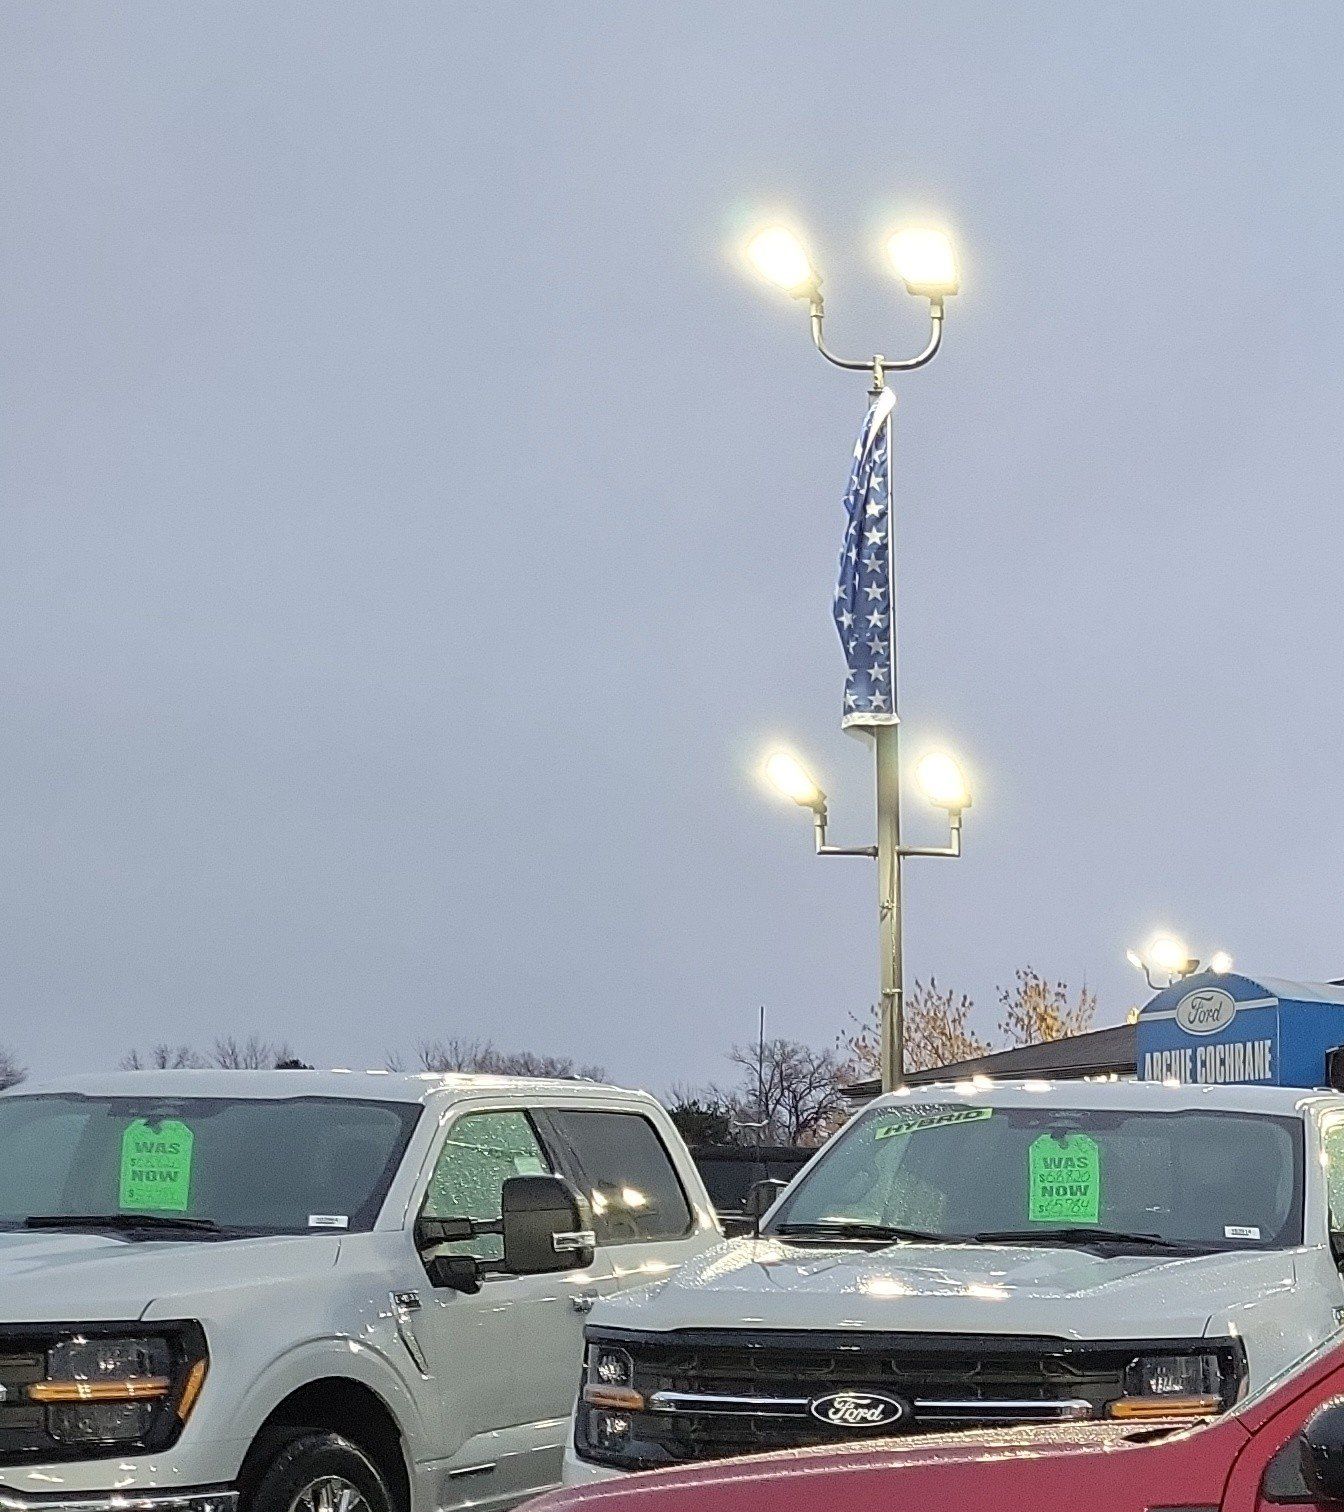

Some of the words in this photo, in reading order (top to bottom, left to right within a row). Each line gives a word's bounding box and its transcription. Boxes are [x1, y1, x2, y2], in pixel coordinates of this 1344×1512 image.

[1187, 995, 1223, 1025] Ford
[1144, 1048, 1193, 1084] ARCHIE
[1196, 1039, 1272, 1084] COCHRANE
[883, 1109, 983, 1136] HYBRID
[134, 1141, 181, 1155] WAS
[1043, 1156, 1089, 1170] WAS
[131, 1169, 179, 1183] NOW
[1041, 1184, 1090, 1198] NOW
[828, 1397, 885, 1422] Ford
